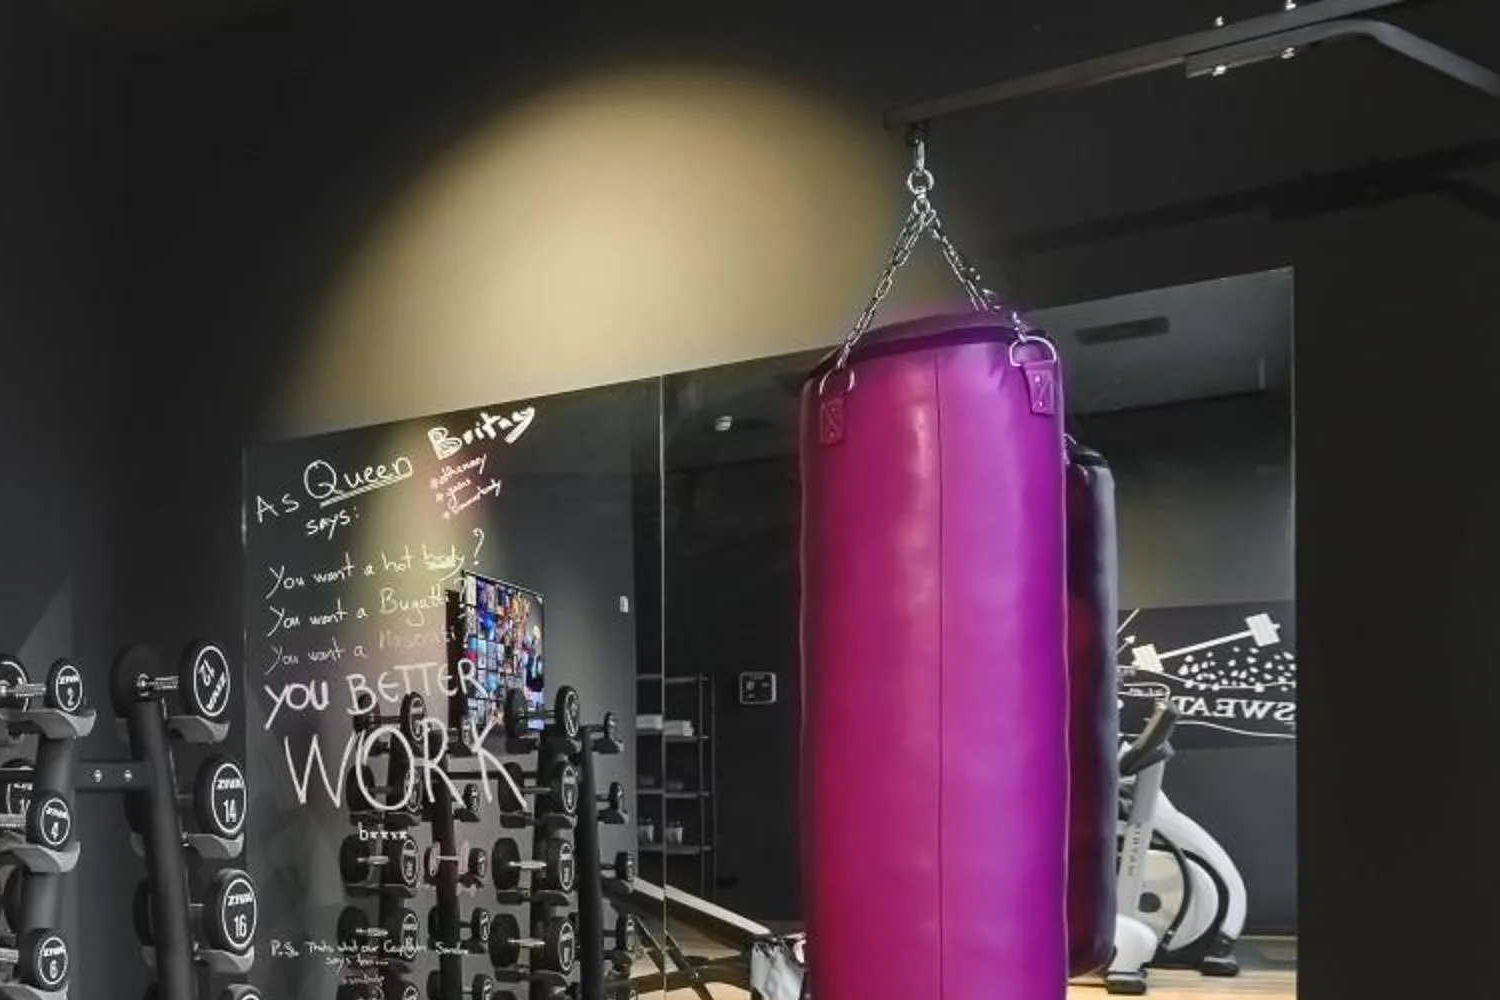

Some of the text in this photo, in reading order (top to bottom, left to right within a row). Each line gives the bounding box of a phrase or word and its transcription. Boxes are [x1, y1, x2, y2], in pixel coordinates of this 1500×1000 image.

[256, 492, 300, 524] As
[303, 456, 414, 502] Queen
[264, 564, 305, 600] You
[312, 551, 356, 583] want
[363, 564, 376, 577] a
[381, 545, 414, 573] hot
[265, 604, 300, 638] You
[264, 643, 300, 676] You
[65, 686, 75, 707] 2
[264, 659, 490, 731] YOU BETTER
[283, 716, 529, 812] WORK
[222, 797, 238, 823] 14
[50, 821, 60, 841] 4
[233, 913, 248, 939] 16
[49, 959, 59, 980] 6
